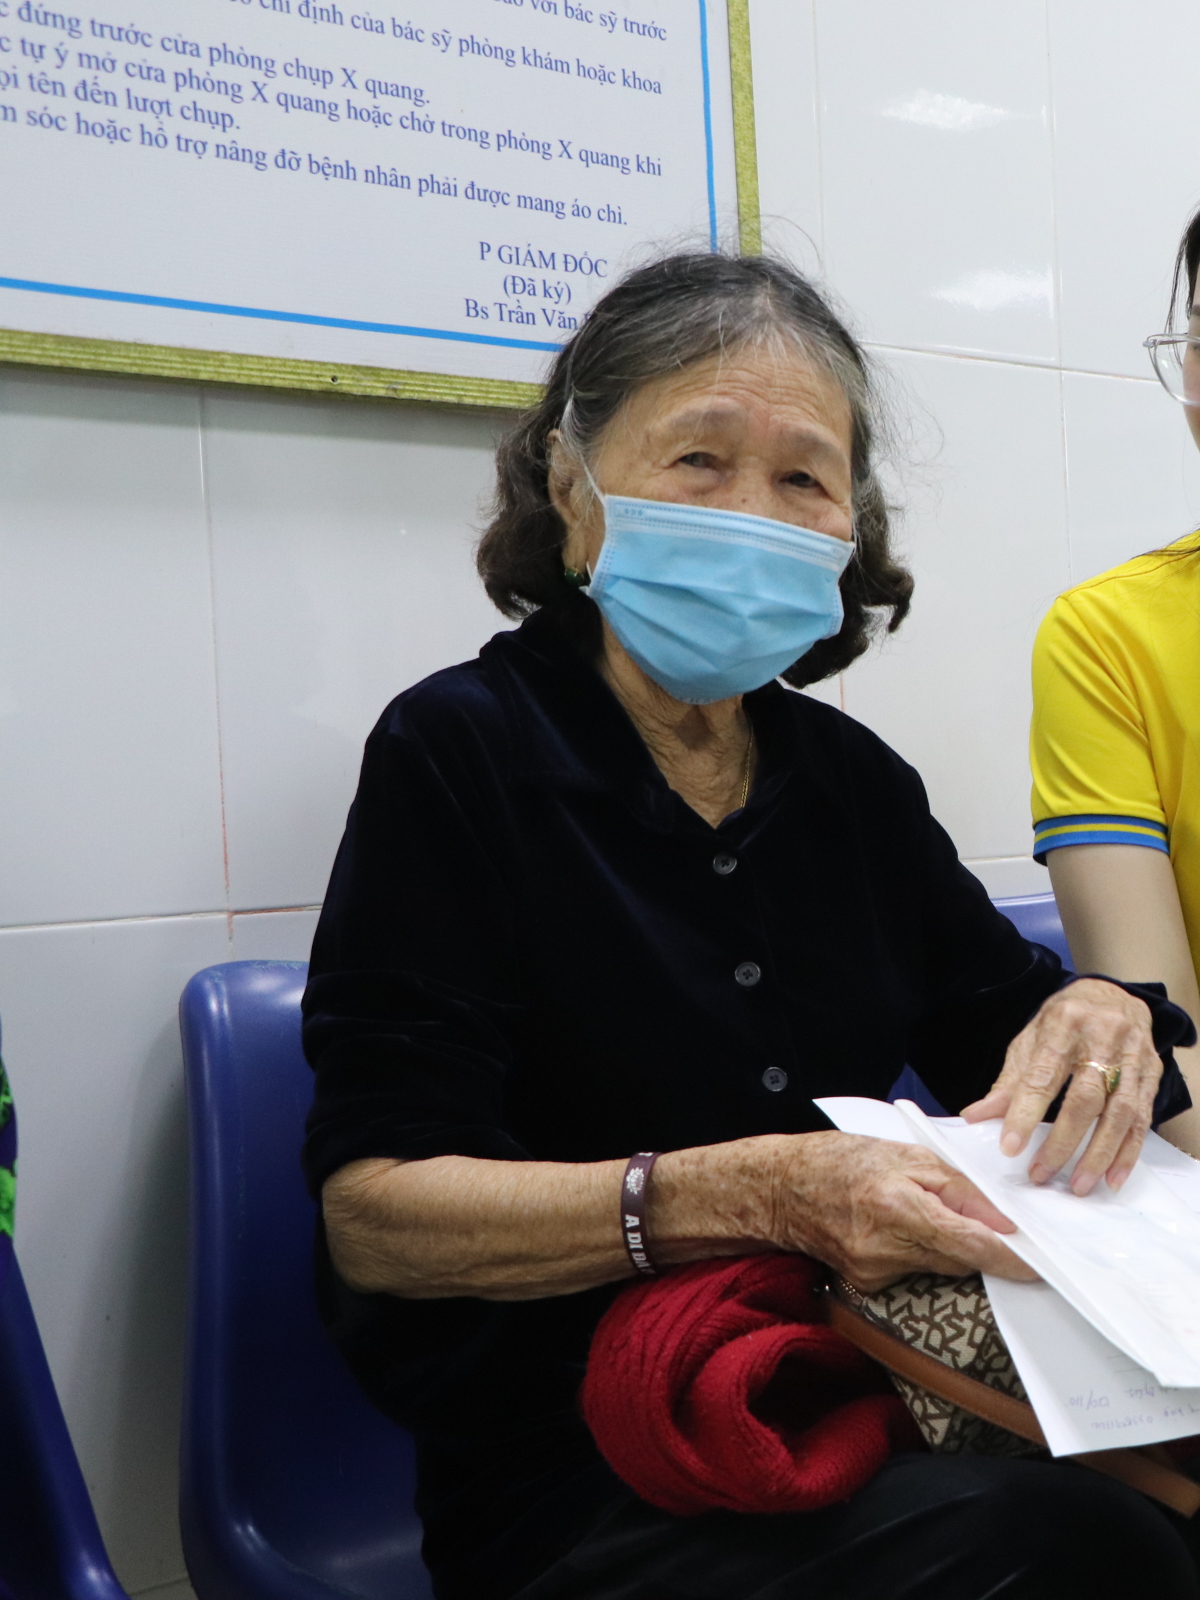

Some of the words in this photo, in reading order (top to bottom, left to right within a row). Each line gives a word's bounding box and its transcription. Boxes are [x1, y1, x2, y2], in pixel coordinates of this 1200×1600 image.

[563, 0, 594, 24] bác
[599, 10, 618, 34] sỹ
[623, 17, 667, 42] trước
[17, 0, 83, 40] đứng
[89, 18, 153, 48] trước
[160, 32, 202, 59] cửa
[208, 42, 278, 79] phòng
[282, 57, 335, 90] chụp
[339, 67, 359, 90] X
[364, 78, 431, 108] quang.
[297, 0, 344, 26] định
[350, 11, 386, 35] của
[390, 16, 425, 43] bác
[431, 28, 453, 54] sỹ
[458, 34, 517, 68] phòng
[521, 45, 571, 75] khám
[575, 57, 617, 86] hoặc
[621, 68, 663, 95] khoa
[19, 37, 47, 64] tự
[54, 42, 69, 70] ý
[124, 58, 167, 84] cửa
[173, 67, 244, 105] phòng
[251, 80, 269, 104] X
[275, 92, 341, 123] quang
[345, 98, 393, 129] hoặc
[398, 110, 436, 134] chờ
[440, 120, 491, 150] trong
[495, 129, 553, 161] phòng
[557, 139, 574, 160] X
[578, 148, 632, 176] quang
[635, 153, 662, 177] khi
[27, 71, 67, 98] tên
[73, 75, 118, 108] đến
[125, 87, 173, 120] lượt
[179, 100, 241, 134] chụp.
[26, 106, 67, 132] sóc
[75, 111, 132, 145] hoặc
[175, 133, 209, 160] trợ
[214, 139, 268, 172] nâng
[306, 152, 358, 182] bệnh
[363, 164, 412, 190] nhân
[417, 173, 458, 198] phải
[463, 180, 511, 208] được
[516, 194, 567, 220] mang
[570, 198, 592, 220] áo
[596, 203, 628, 226] chì.
[479, 241, 492, 261] P
[496, 242, 557, 271] GIÁM
[562, 251, 608, 278] ĐỐC
[502, 274, 538, 298] (Đã
[542, 278, 572, 305] ký)
[464, 297, 490, 320] Bs
[493, 298, 537, 326] Trần
[540, 307, 577, 329] Văn
[624, 1213, 640, 1228] A
[626, 1231, 644, 1250] DI
